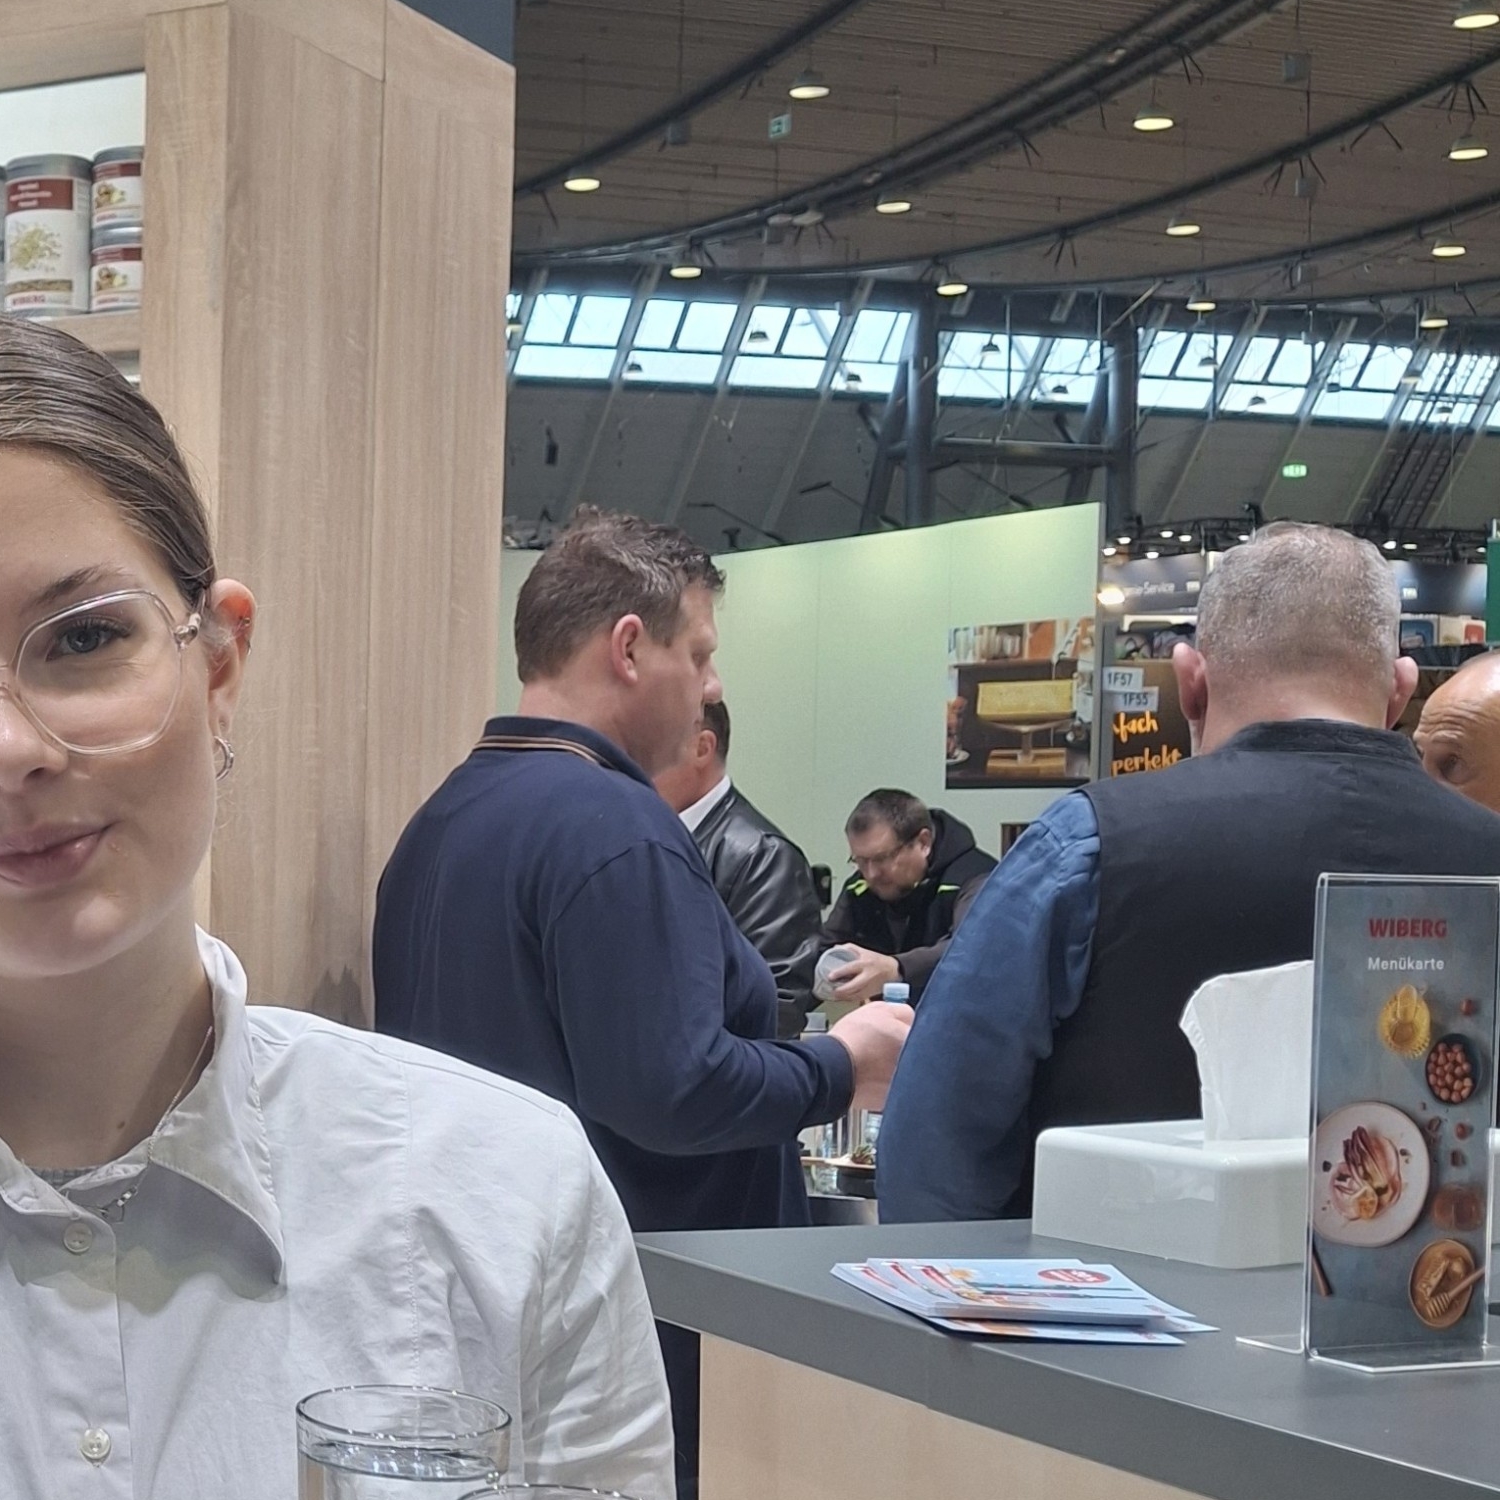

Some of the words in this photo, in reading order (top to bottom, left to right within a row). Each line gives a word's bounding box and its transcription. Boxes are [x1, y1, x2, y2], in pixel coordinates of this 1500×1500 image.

[1107, 672, 1134, 686] 1F57
[1123, 692, 1149, 706] 1F55
[1111, 744, 1182, 778] perfekt
[1368, 918, 1448, 938] WIBERG
[1367, 956, 1445, 971] Menükarte
